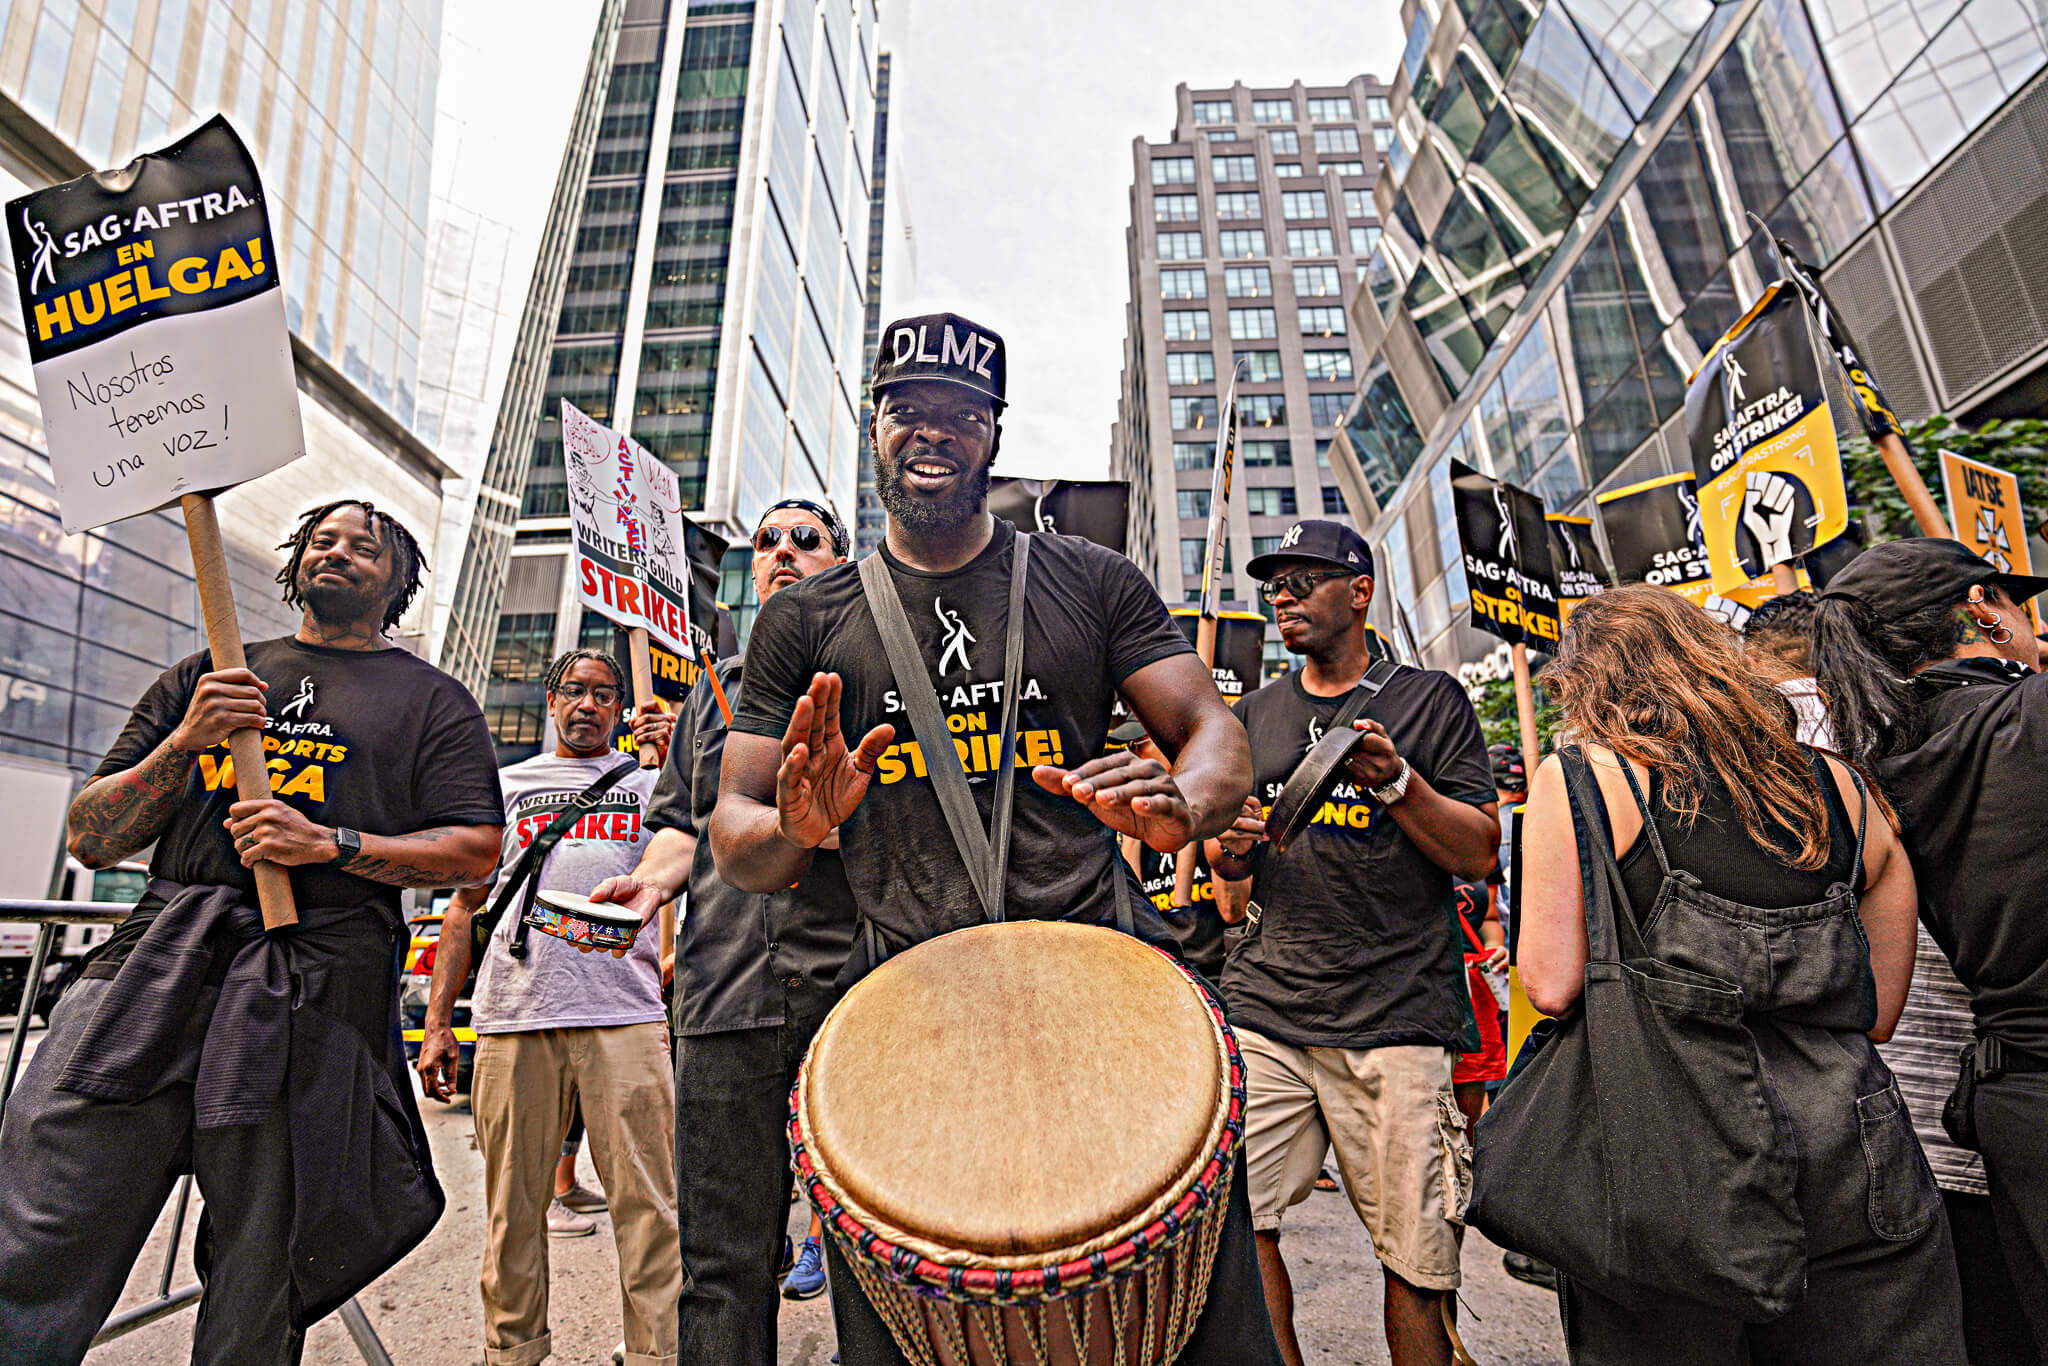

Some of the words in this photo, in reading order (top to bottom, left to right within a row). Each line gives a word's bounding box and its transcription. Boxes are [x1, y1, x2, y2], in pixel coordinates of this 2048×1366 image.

[116, 240, 155, 266] EN
[34, 237, 266, 341] HUELGA!
[893, 325, 996, 380] DLMZ
[108, 394, 206, 439] tenemos
[1710, 443, 1735, 472] ON
[1732, 394, 1804, 454] STRIKE!
[93, 455, 145, 487] una
[576, 519, 648, 569] WRITERS
[650, 557, 684, 595] GUILD
[1645, 562, 1683, 586] ON
[580, 556, 690, 647] STRIKE!
[1471, 588, 1560, 642] STRIKE!
[946, 711, 988, 733] ON
[519, 792, 577, 811] WRITER
